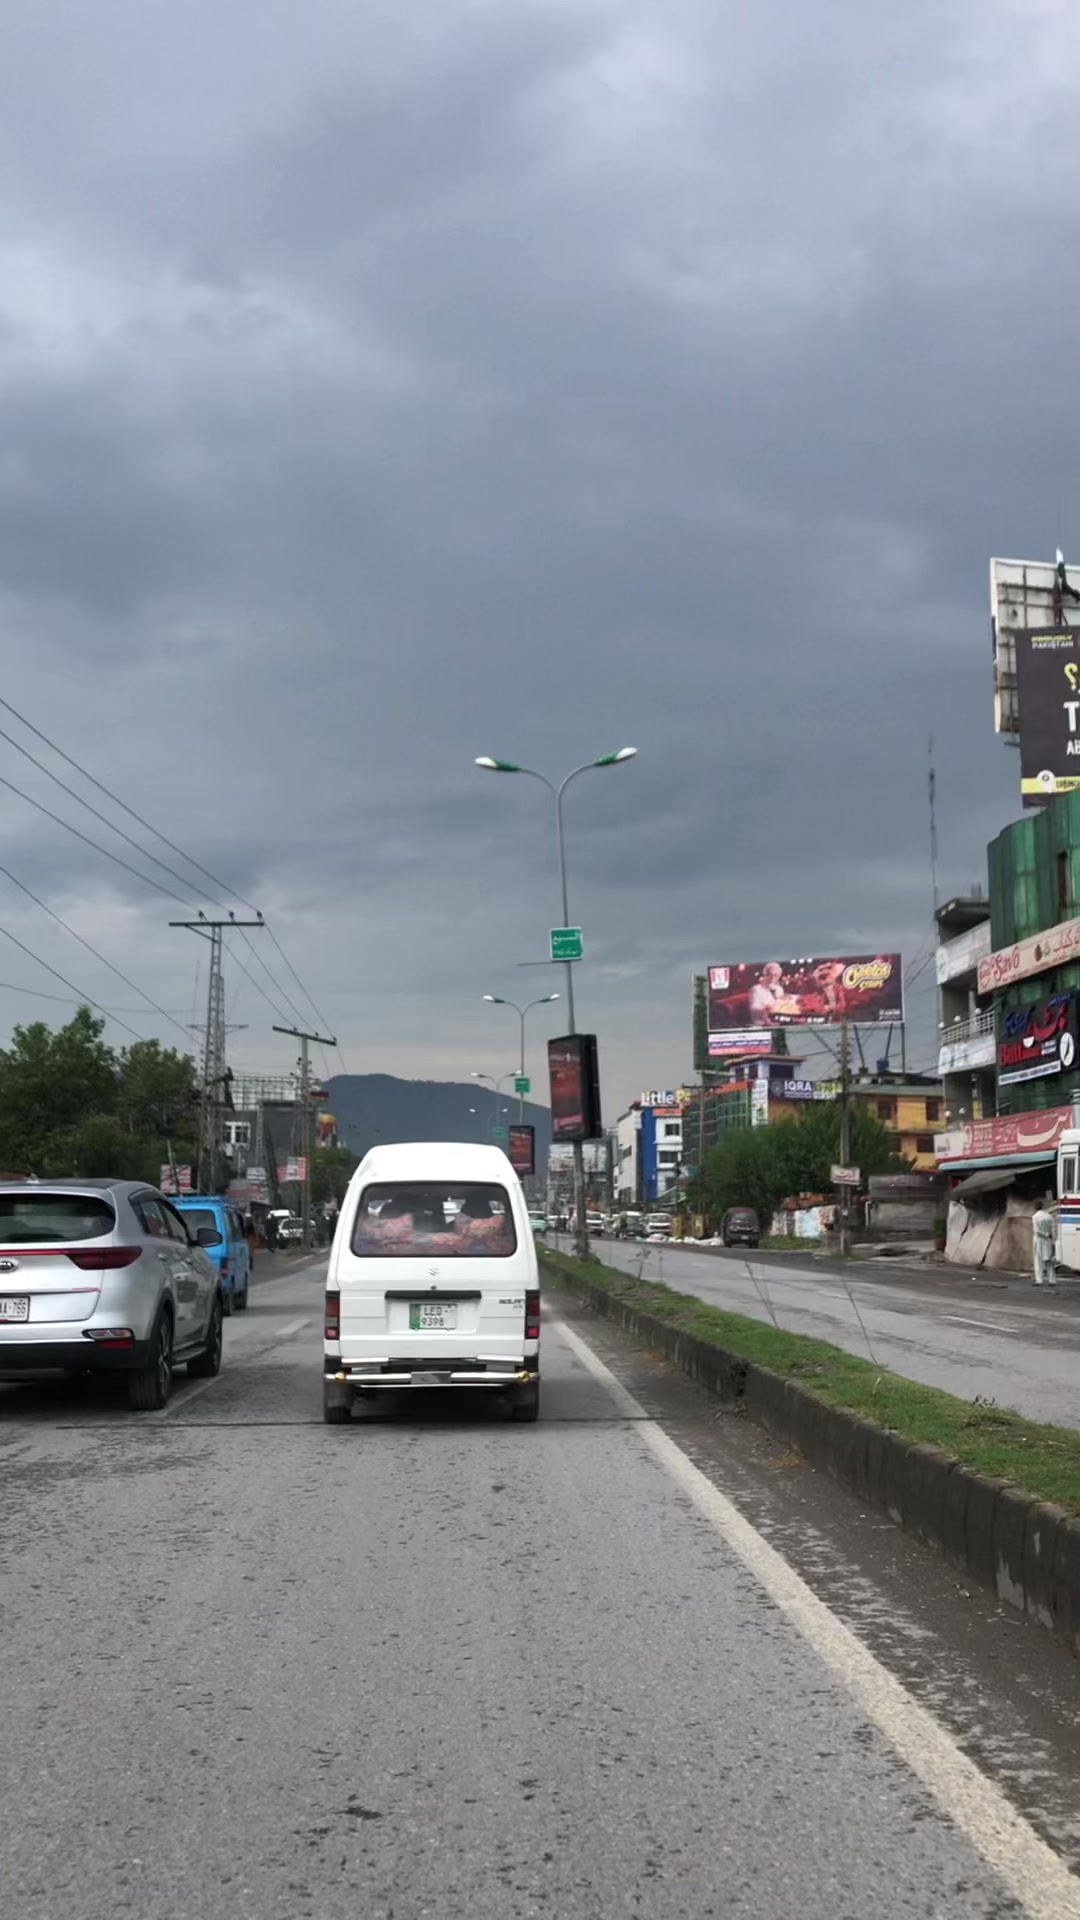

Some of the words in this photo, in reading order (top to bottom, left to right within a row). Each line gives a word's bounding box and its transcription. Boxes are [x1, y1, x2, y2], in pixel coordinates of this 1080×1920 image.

[784, 1080, 812, 1091] IQRA
[640, 1089, 674, 1106] Little
[422, 1317, 445, 1326] 9398
